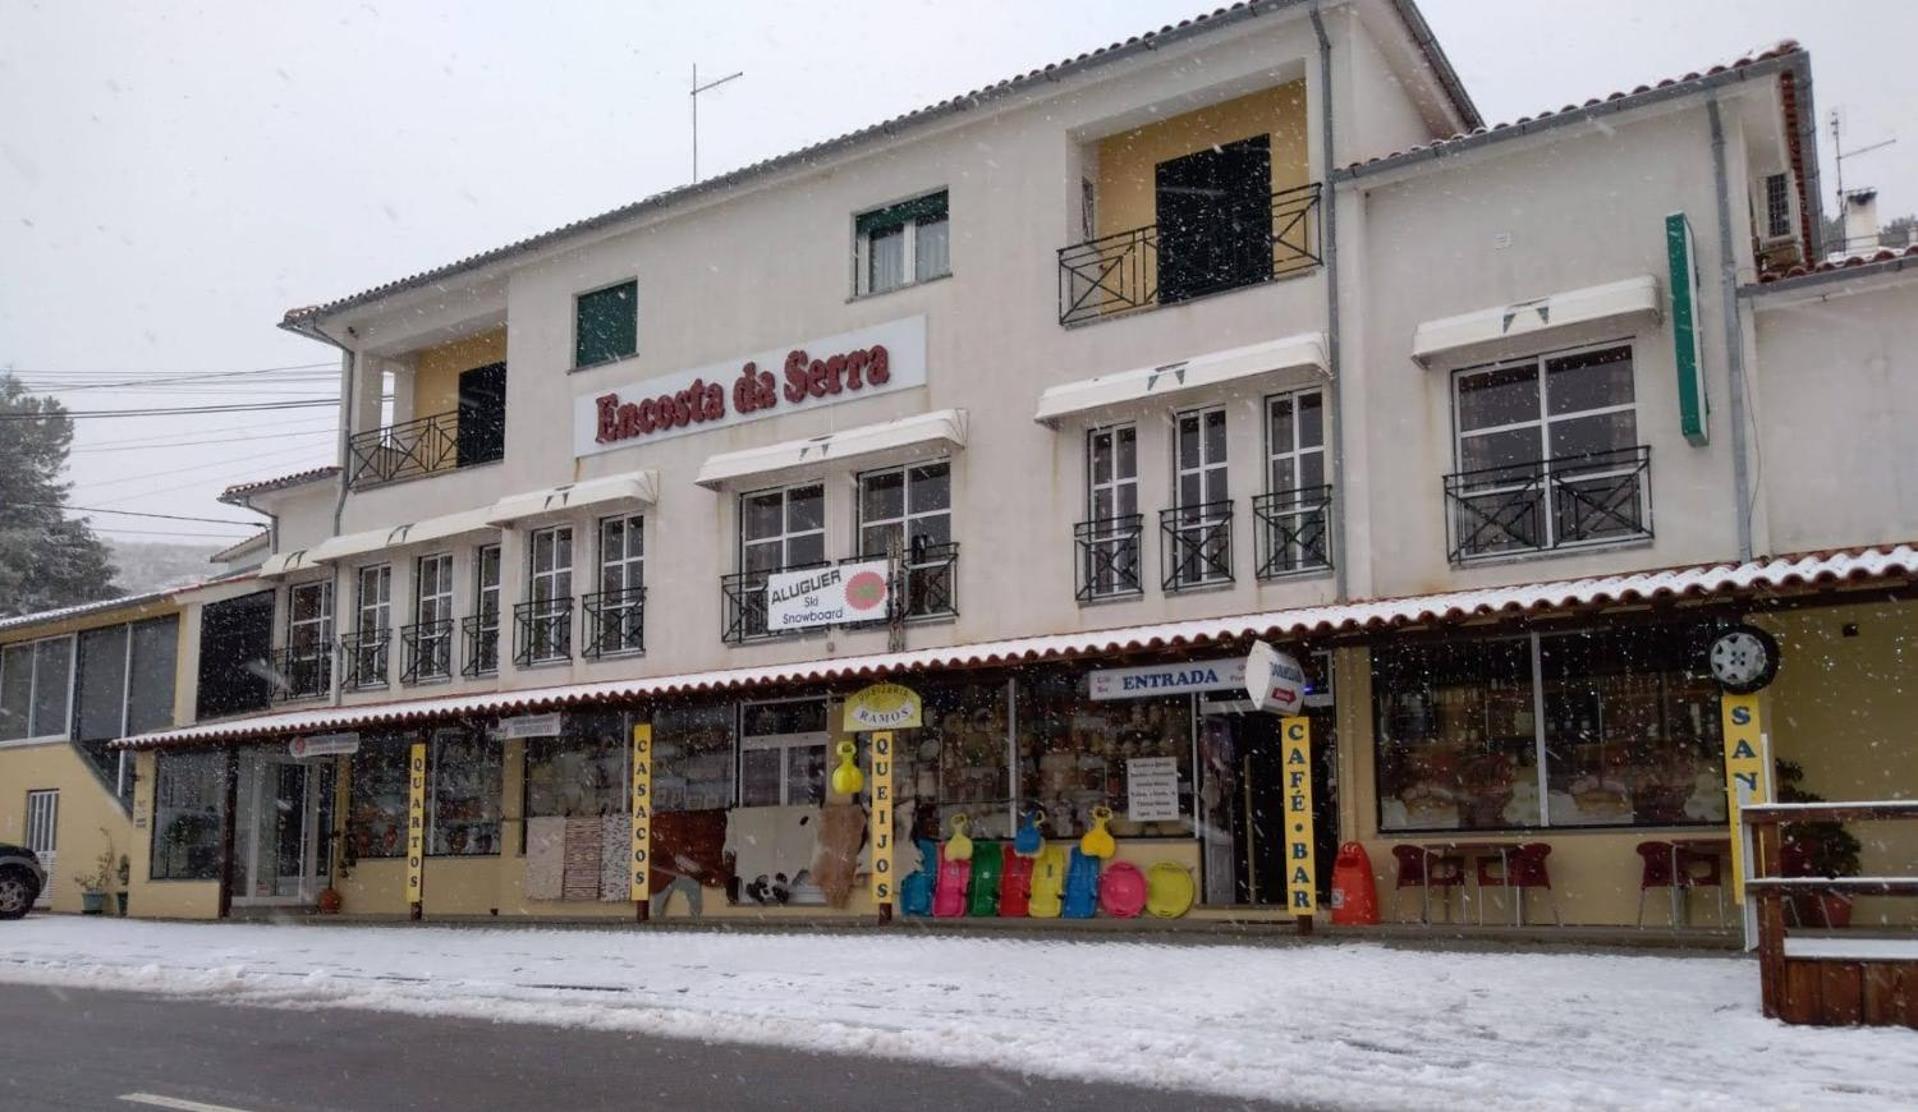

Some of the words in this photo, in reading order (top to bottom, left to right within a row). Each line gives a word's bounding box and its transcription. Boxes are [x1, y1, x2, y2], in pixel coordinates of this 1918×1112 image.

[596, 378, 725, 443] Encosta
[733, 361, 777, 414] da
[784, 345, 891, 403] Serra
[771, 569, 841, 605] ALUGUER
[783, 609, 844, 625] Snowboard
[804, 596, 818, 607] Ski
[1122, 668, 1219, 691] ENTRADA
[860, 707, 909, 723] RAMOS
[1287, 724, 1305, 812] CAFÉ
[410, 757, 423, 888] QUARTOS
[635, 740, 647, 885] CASACOS
[875, 738, 889, 898] QUEIJOS
[1291, 842, 1311, 909] BAR
